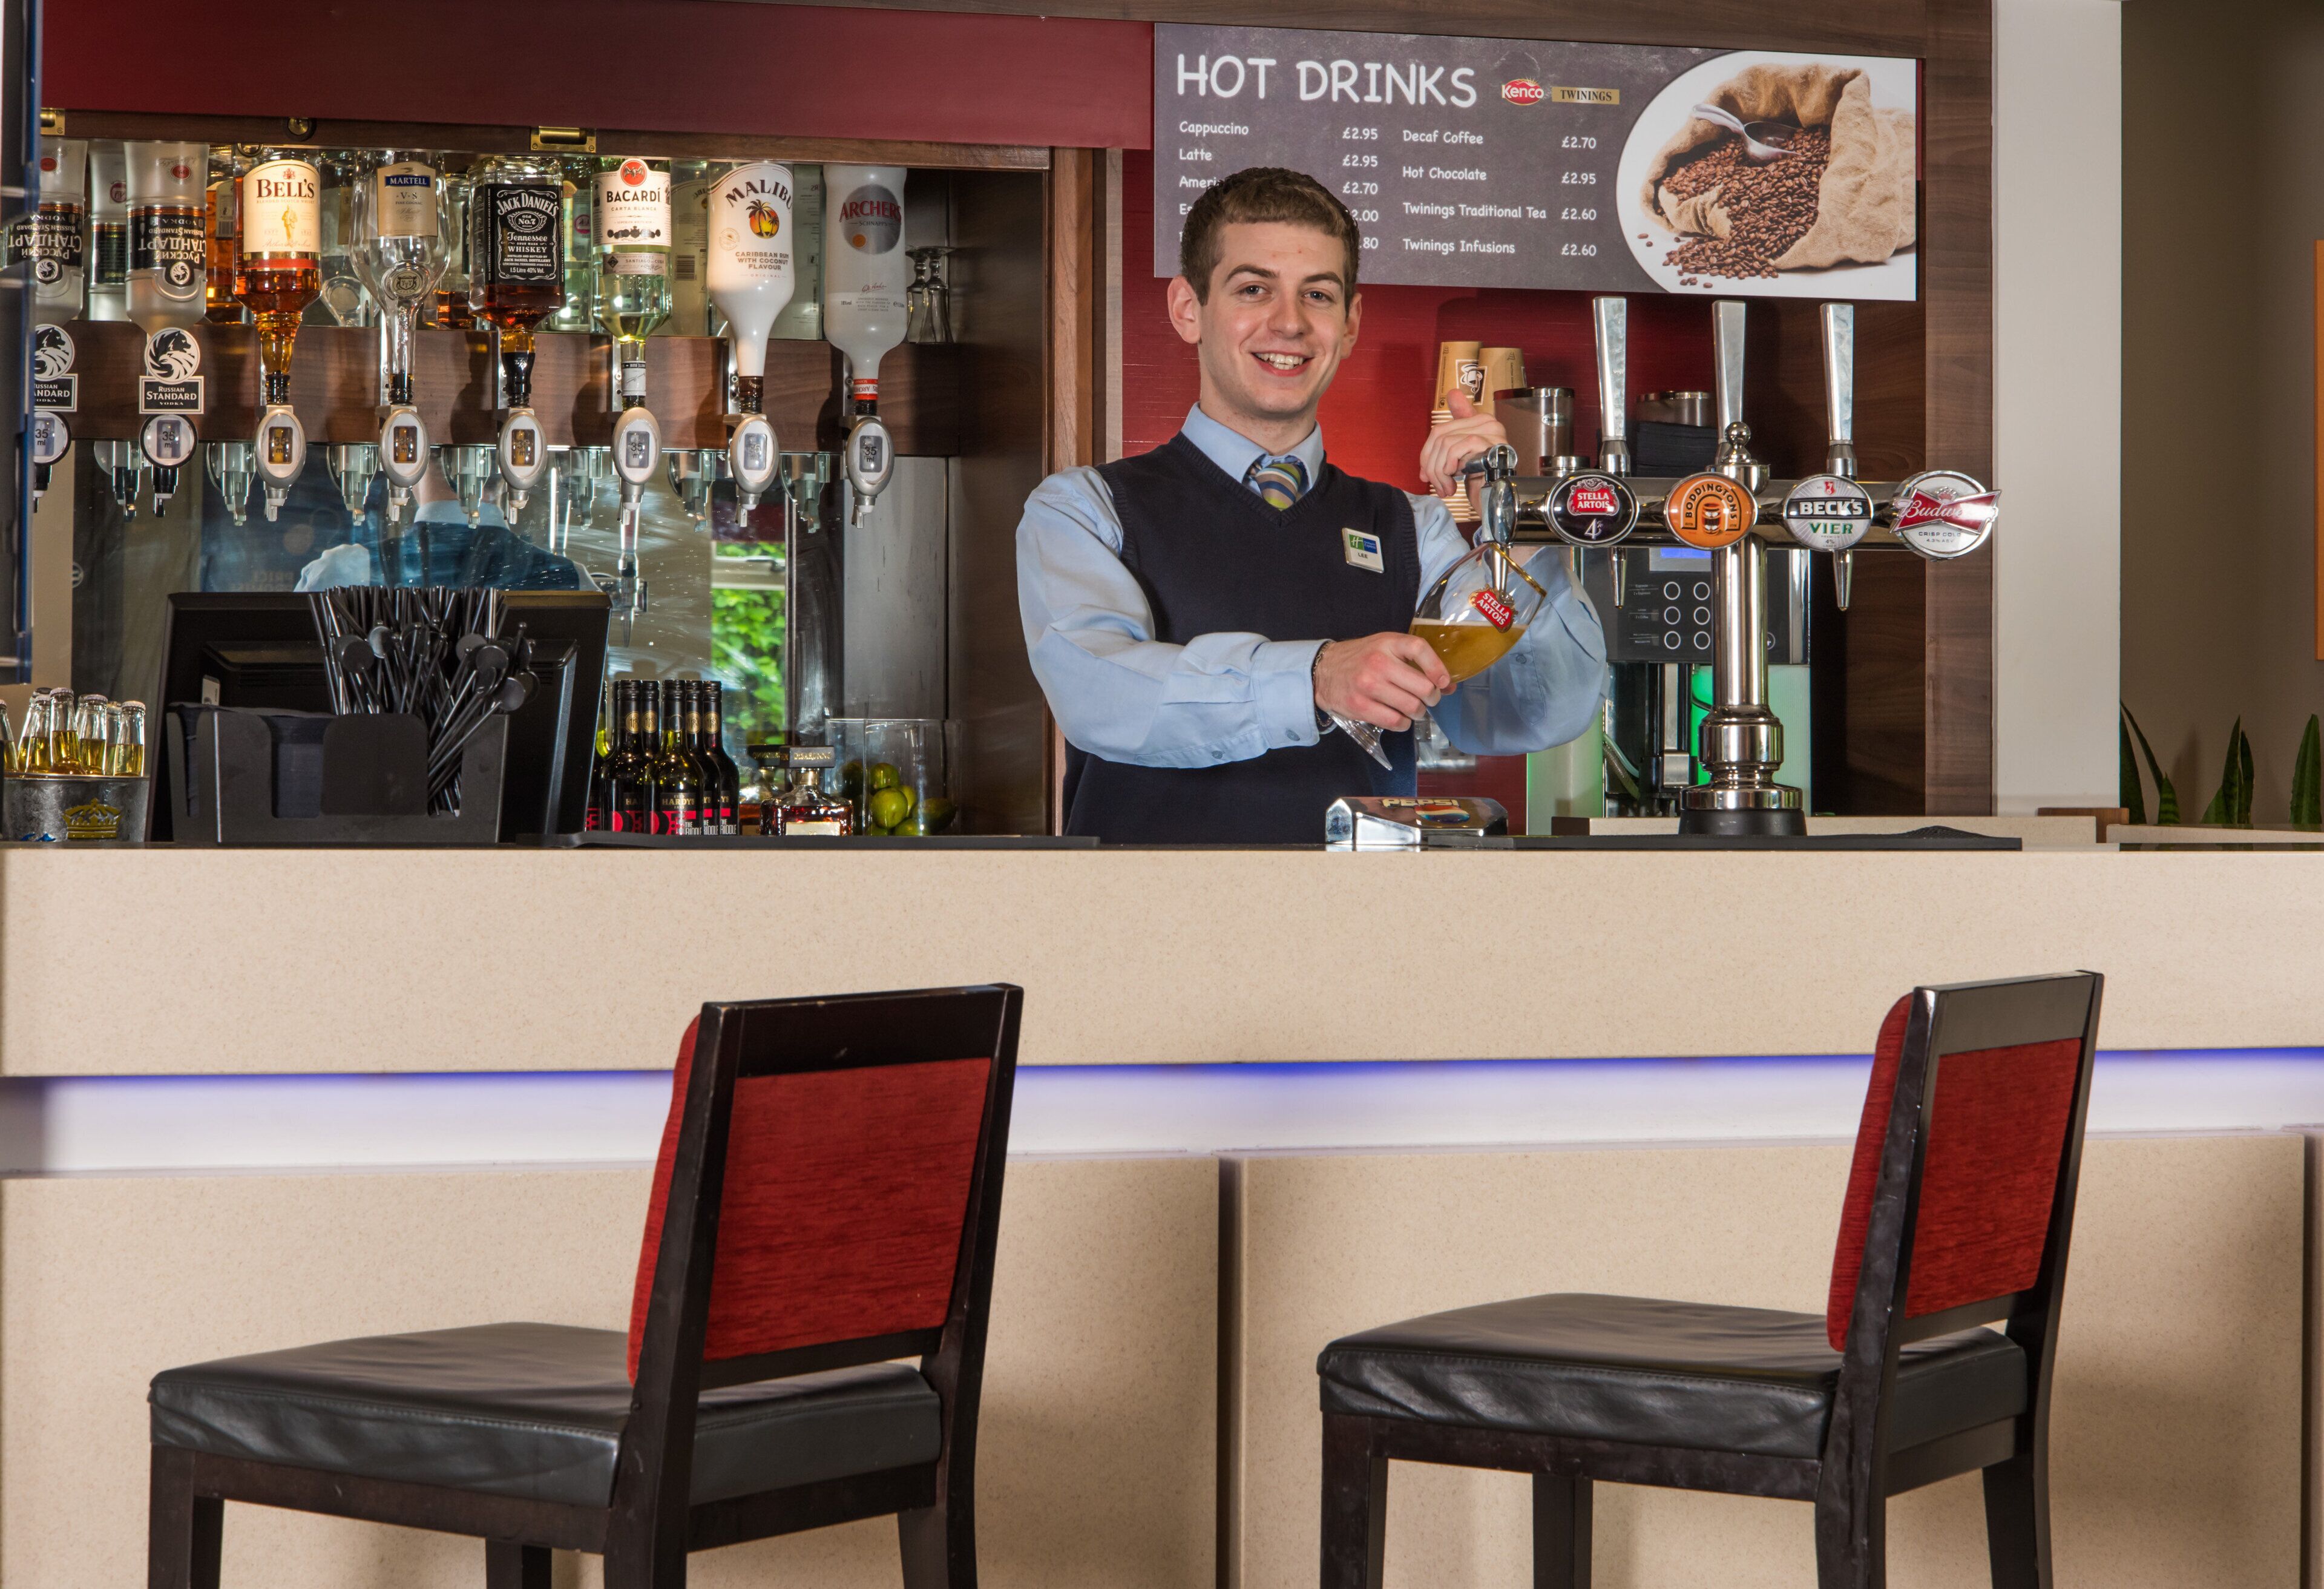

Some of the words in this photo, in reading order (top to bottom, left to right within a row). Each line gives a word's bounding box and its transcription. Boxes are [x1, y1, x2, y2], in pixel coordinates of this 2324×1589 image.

[1177, 53, 1277, 100] HOT
[1295, 59, 1477, 108] DRINKS
[1502, 84, 1544, 99] Kenco
[1560, 89, 1612, 102] TWININGS
[1179, 120, 1249, 137] Cappuccino
[1342, 127, 1379, 140] £2.95
[1402, 129, 1439, 143] Decaf
[1443, 130, 1483, 145] Coffee
[1561, 136, 1597, 150] £2.70
[1179, 148, 1212, 162] Latte
[1342, 154, 1379, 168] £2.95
[1402, 165, 1425, 179] Hot
[1428, 166, 1487, 181] Chocolate
[1561, 171, 1597, 185] £2.95
[724, 179, 793, 210] MALIBU
[1179, 175, 1219, 188] Ameri
[1342, 181, 1379, 196] £2.70
[496, 196, 521, 215] JACK
[521, 192, 559, 217] DANIEL'S
[606, 188, 660, 203] BACARDÍ
[839, 200, 901, 223] ARCHERS
[1351, 208, 1379, 222] 2.00
[1402, 202, 1456, 219] Twinings
[1458, 203, 1522, 219] Traditional
[1525, 206, 1547, 219] Tea
[1561, 207, 1597, 222] £2.60
[507, 232, 548, 242] Tennessee
[1402, 238, 1456, 255] Twinings
[1459, 239, 1516, 254] Infusions
[1561, 243, 1597, 257] £2.60
[146, 391, 197, 401] STANDARD
[34, 429, 48, 439] 35
[631, 442, 643, 452] 35
[864, 446, 877, 456] 35
[1685, 483, 1737, 519] BODDINGTONS
[1799, 498, 1863, 516] BECK'S
[1809, 522, 1854, 535] VIER
[1477, 599, 1506, 625] ARTOIS
[1482, 593, 1510, 620] STELLA
[1382, 798, 1459, 808] PEPSI
[720, 824, 737, 835] RIDDLE
